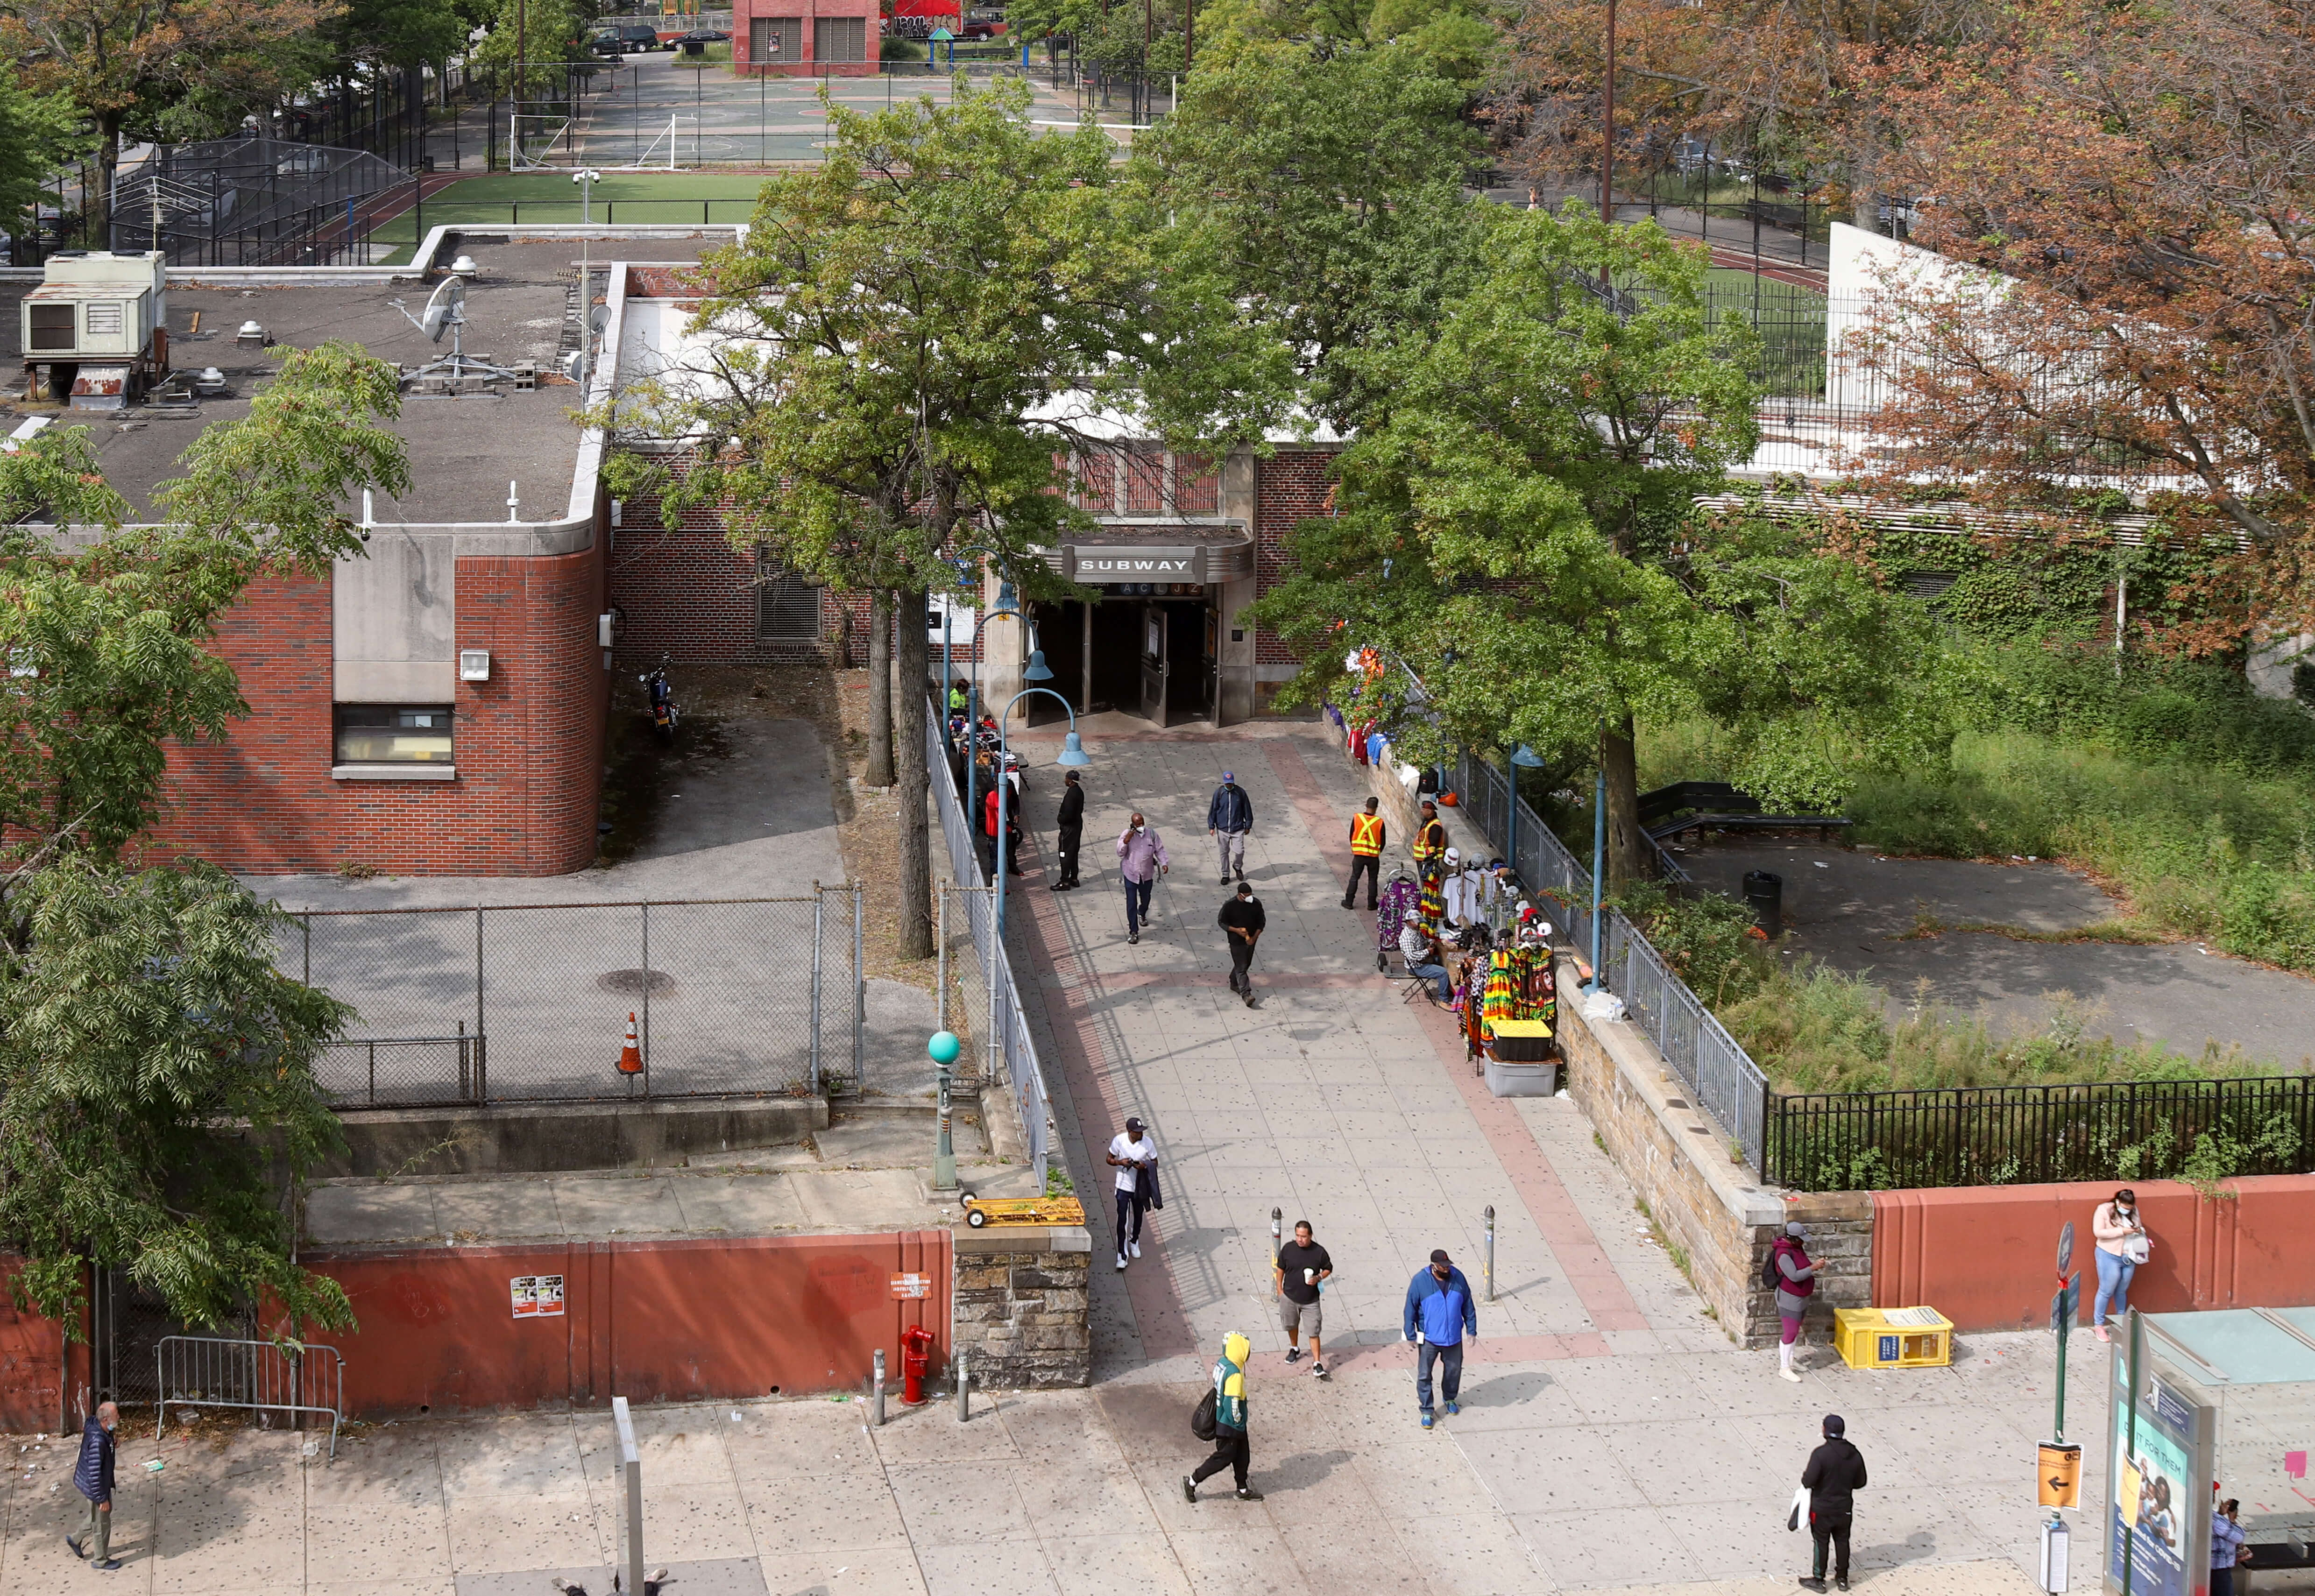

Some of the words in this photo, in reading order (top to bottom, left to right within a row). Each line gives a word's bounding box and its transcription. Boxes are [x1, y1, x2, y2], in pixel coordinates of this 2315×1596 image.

[1081, 560, 1188, 570] SUBWAY
[1123, 584, 1131, 592] A
[1140, 584, 1147, 592] C
[1157, 584, 1164, 592] L
[1174, 584, 1180, 592] J
[1190, 584, 1198, 593] Z
[2136, 1431, 2143, 1443] IT
[2145, 1438, 2159, 1457] FOR
[2161, 1452, 2181, 1476] THEM
